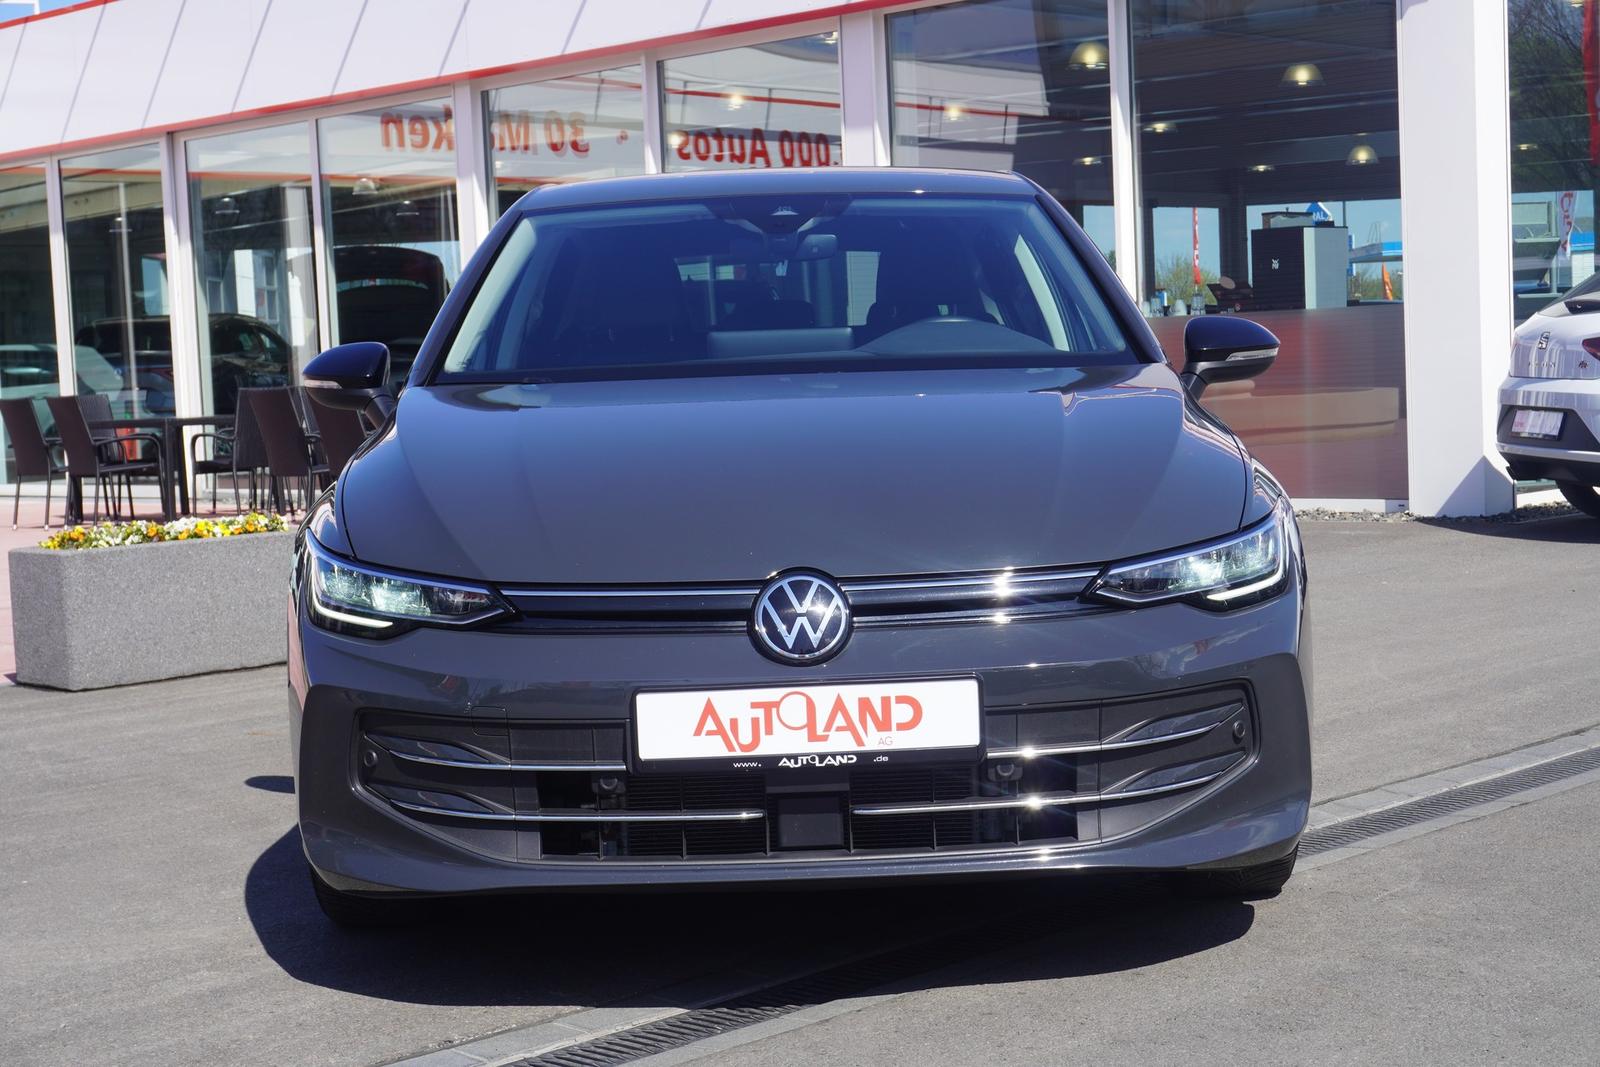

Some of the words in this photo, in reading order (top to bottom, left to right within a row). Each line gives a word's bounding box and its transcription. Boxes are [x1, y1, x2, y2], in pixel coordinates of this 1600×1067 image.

[758, 576, 846, 658] VW
[693, 691, 923, 752] AUTOLAND
[877, 736, 893, 746] AG
[778, 755, 857, 768] AUTOLAND
